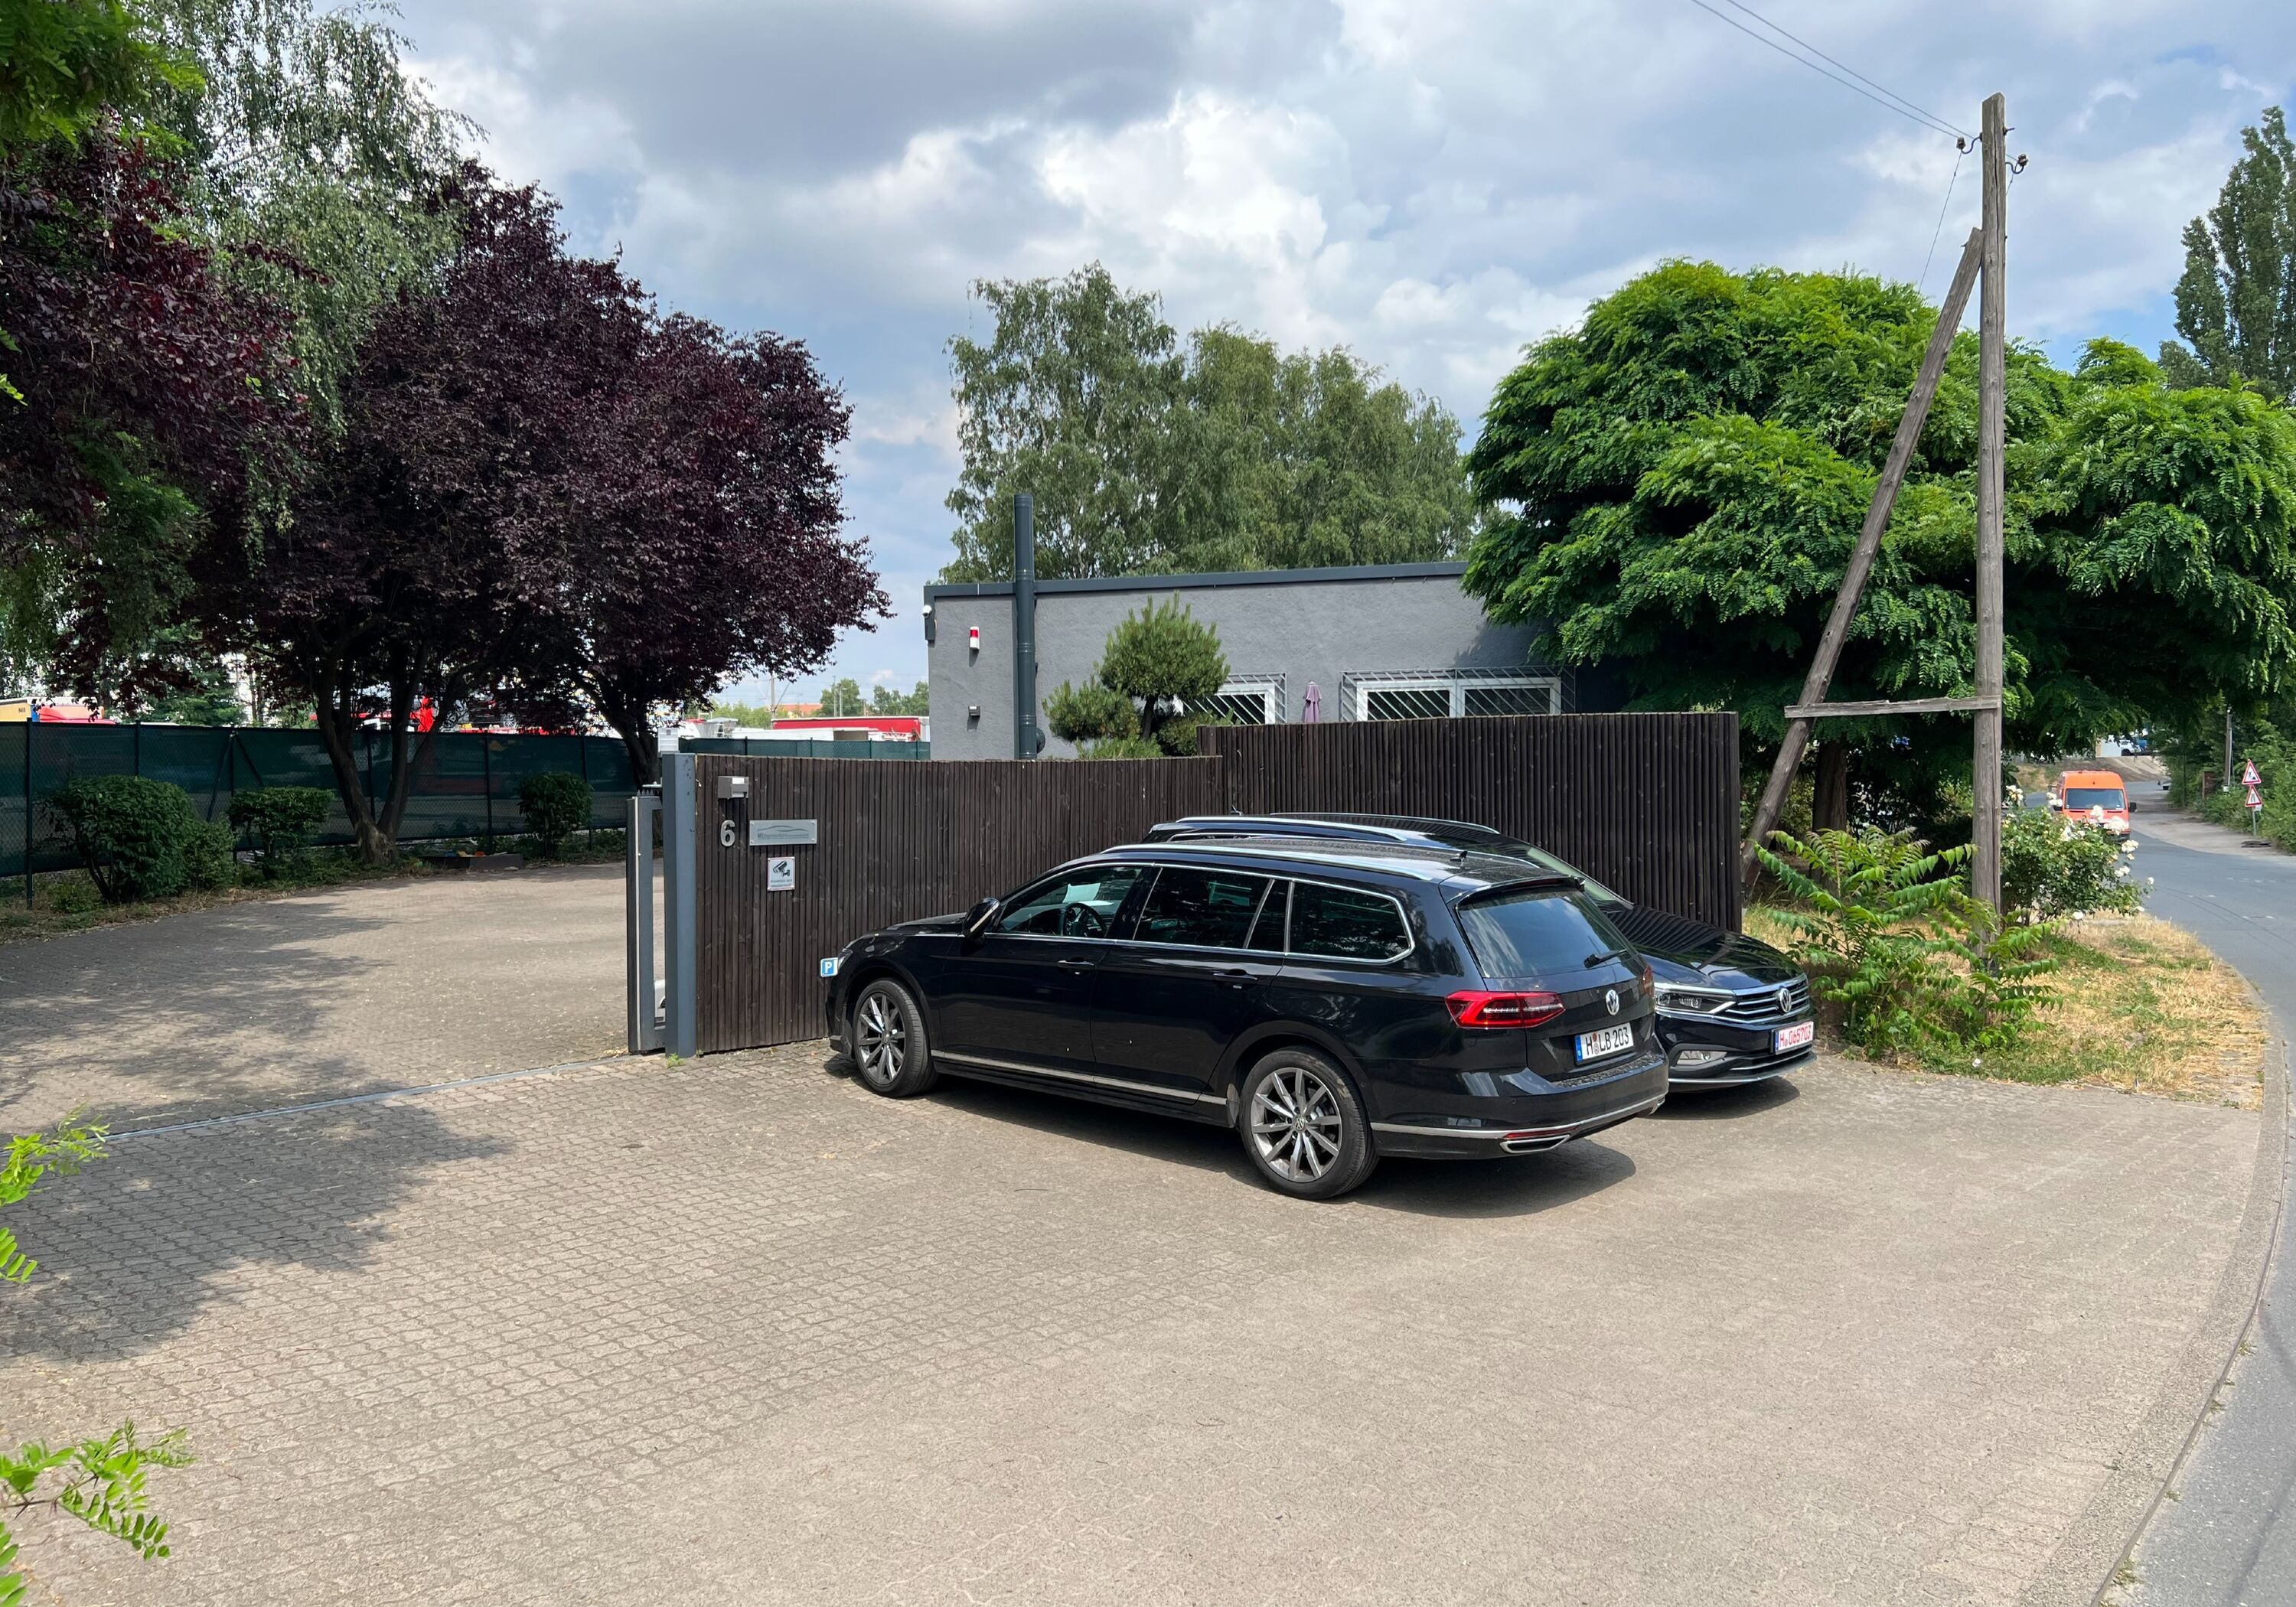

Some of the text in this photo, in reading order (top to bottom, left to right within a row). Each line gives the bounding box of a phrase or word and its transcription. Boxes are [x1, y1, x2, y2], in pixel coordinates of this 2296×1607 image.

[721, 820, 735, 846] 6
[824, 961, 833, 974] P
[1585, 1026, 1629, 1055] H LB 203
[1779, 1032, 1785, 1048] H
